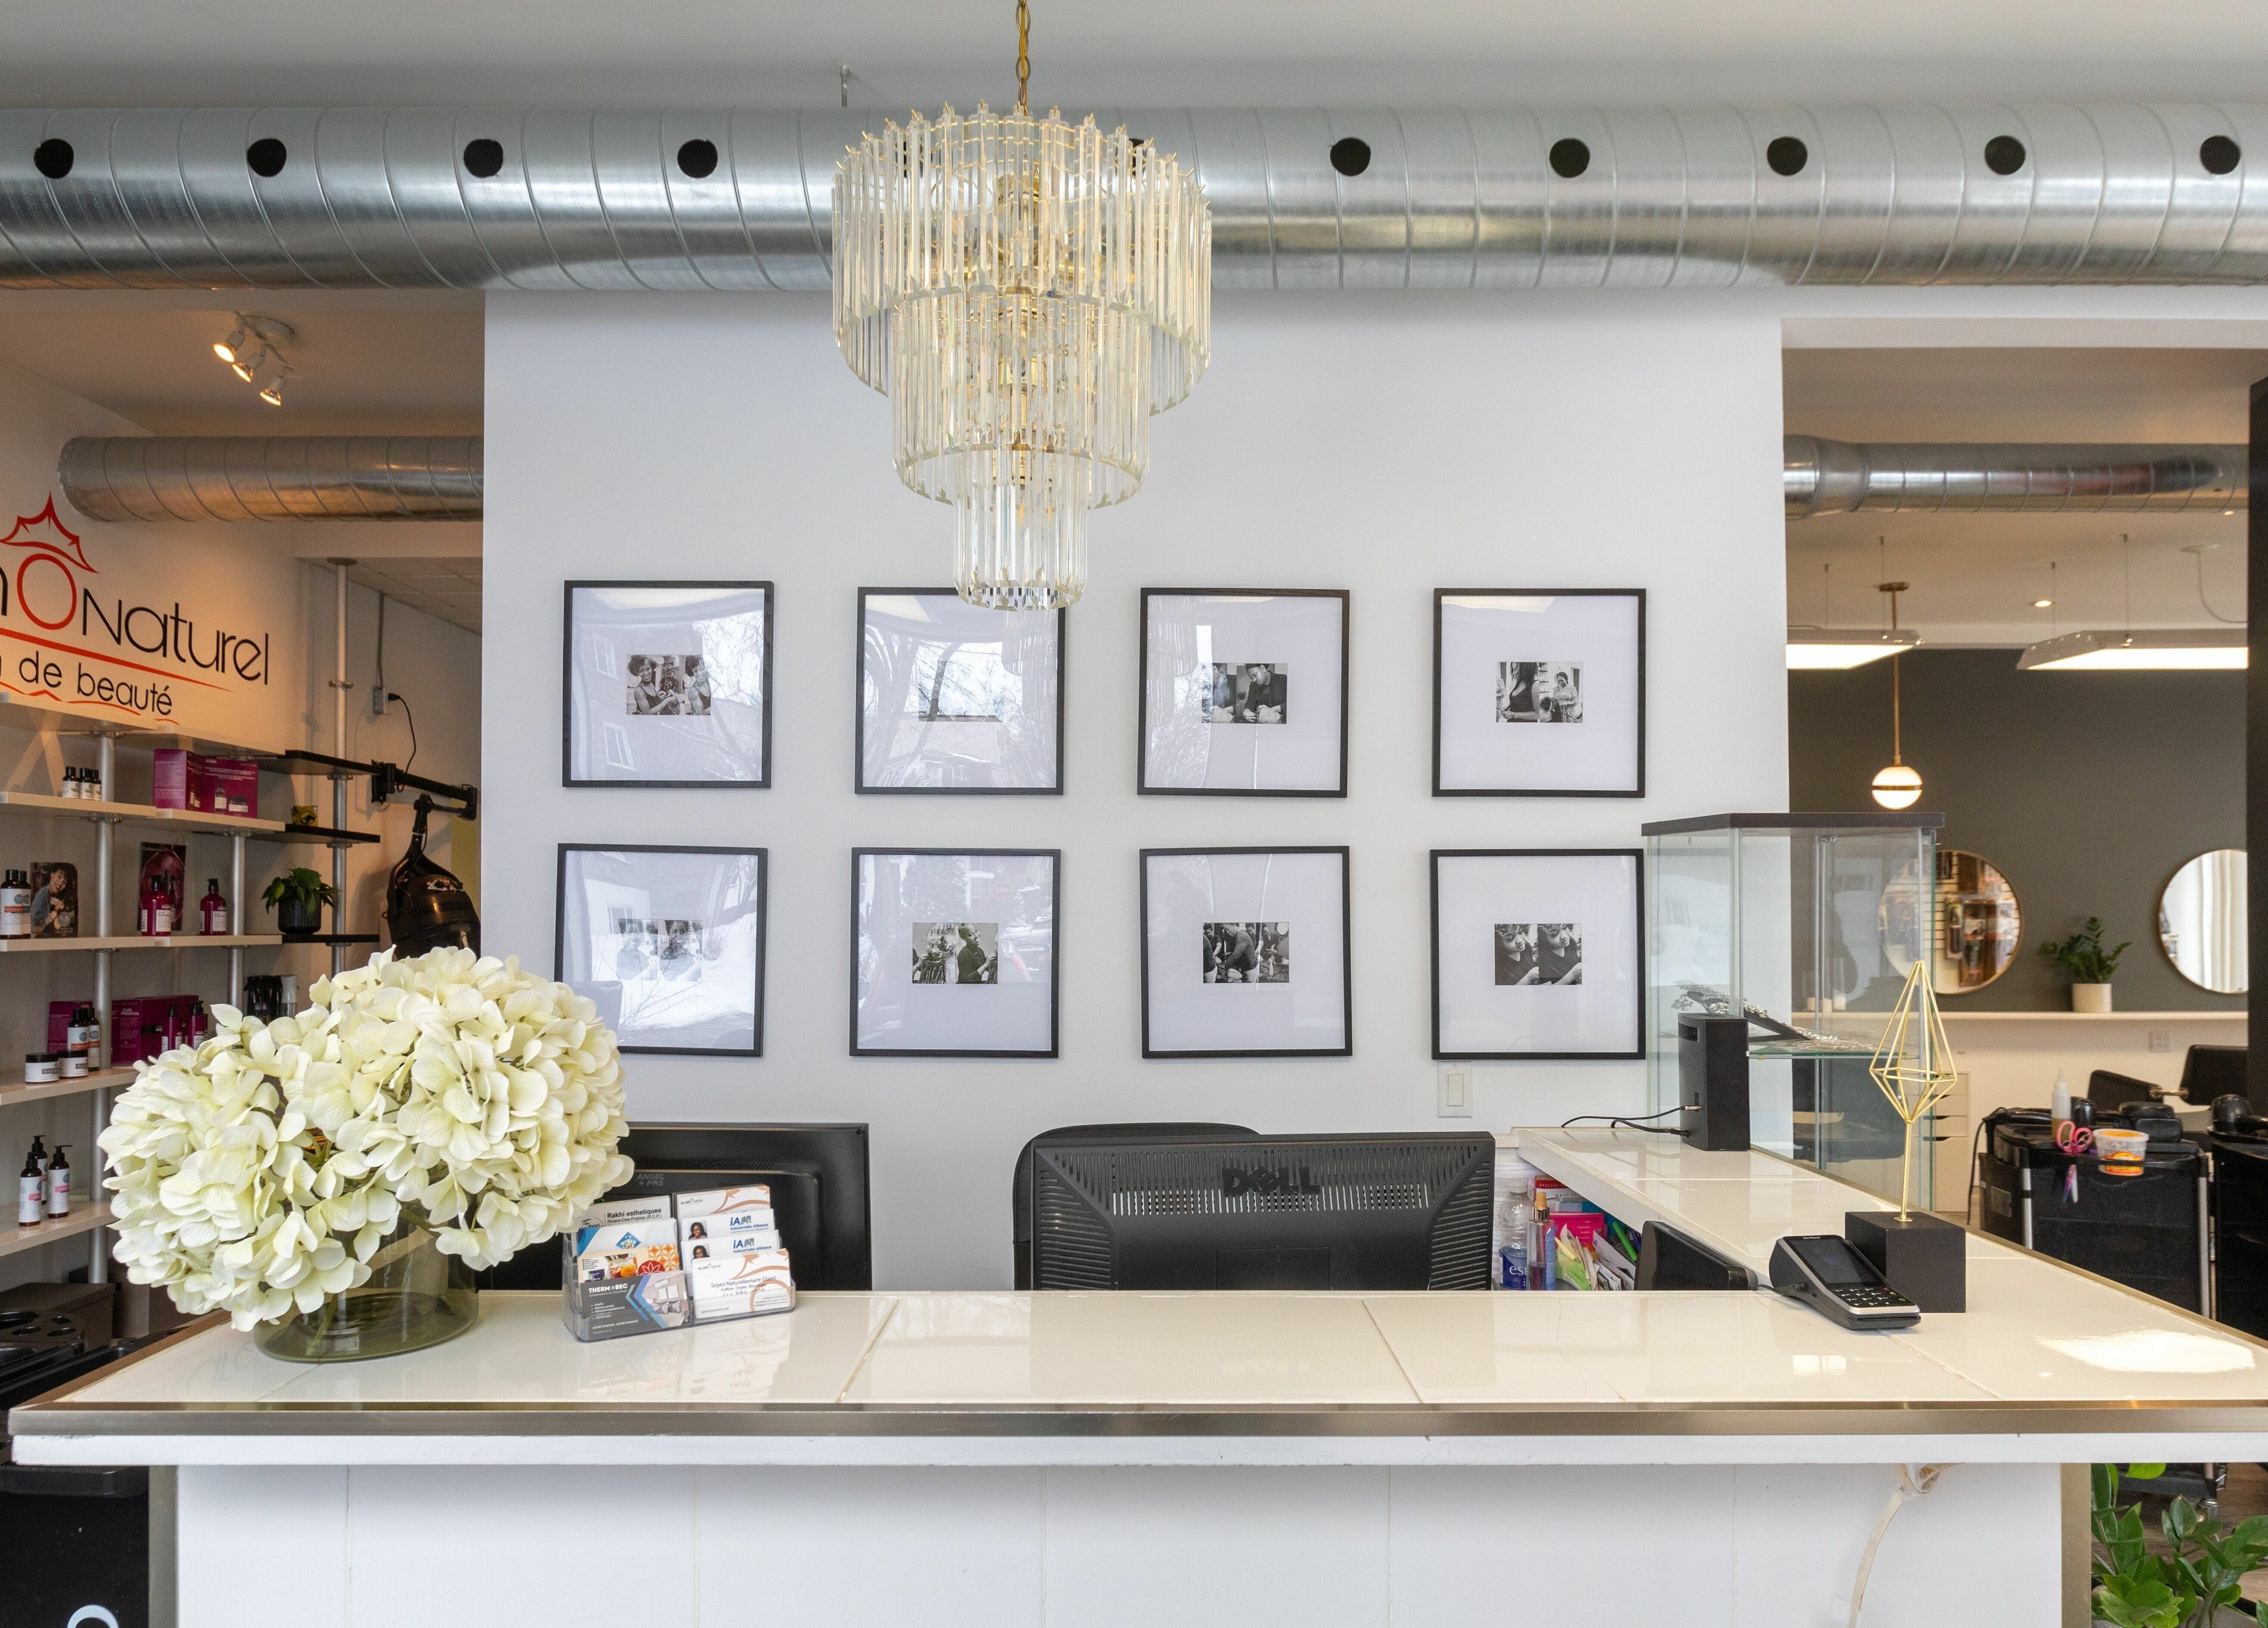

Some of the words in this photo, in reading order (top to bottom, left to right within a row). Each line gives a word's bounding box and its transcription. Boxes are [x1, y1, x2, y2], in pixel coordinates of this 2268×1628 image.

[18, 651, 62, 688] de
[77, 663, 172, 716] beauté
[1221, 1167, 1320, 1196] DELL
[626, 1208, 662, 1216] esthetiques
[726, 1277, 761, 1286] Naturellement
